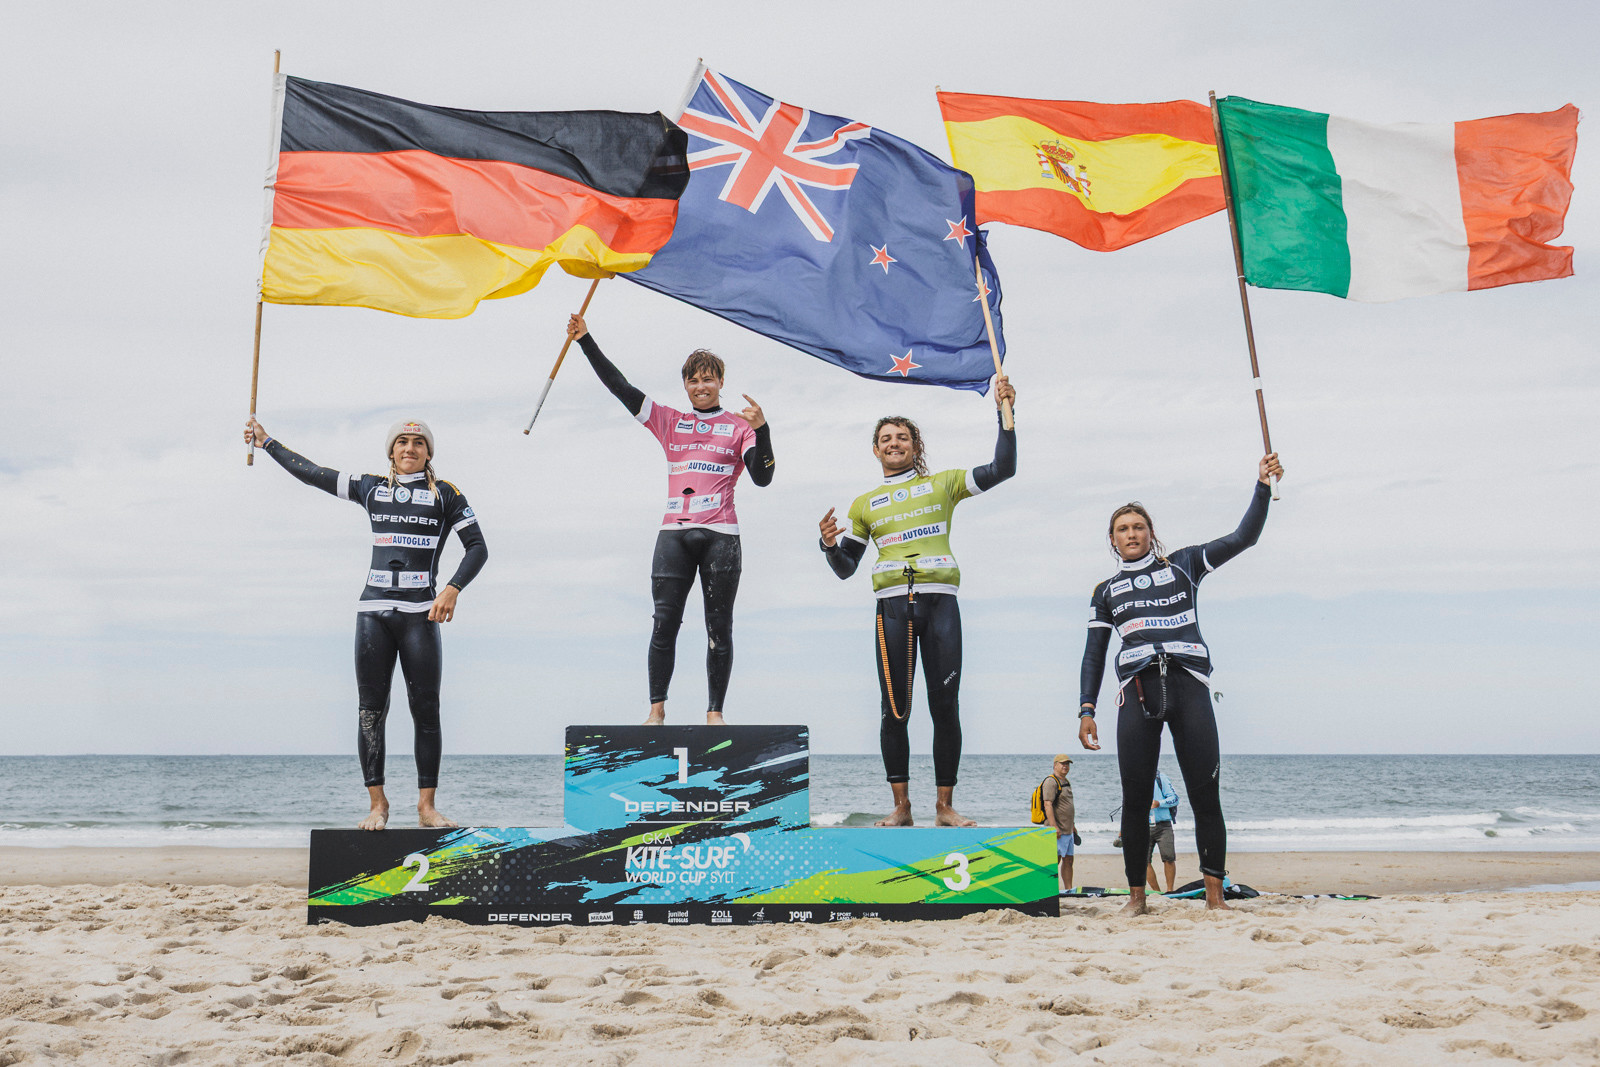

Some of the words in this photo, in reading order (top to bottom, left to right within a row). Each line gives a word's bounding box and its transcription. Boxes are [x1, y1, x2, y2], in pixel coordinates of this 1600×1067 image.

[371, 512, 439, 527] DEFENDER
[870, 504, 942, 530] DEFENDER
[1111, 591, 1187, 617] DEFENDER
[673, 747, 689, 784] 1
[624, 801, 751, 812] DEFENDER
[642, 832, 673, 845] GKA
[624, 846, 736, 870] KITE-SURF
[401, 853, 430, 892] 2
[625, 871, 676, 883] WORLD
[679, 871, 706, 884] CUP
[710, 871, 736, 884] SYLT
[943, 852, 971, 891] 3
[488, 913, 573, 922] DEFENDER
[711, 910, 733, 918] ZOLL
[788, 911, 813, 922] joyn
